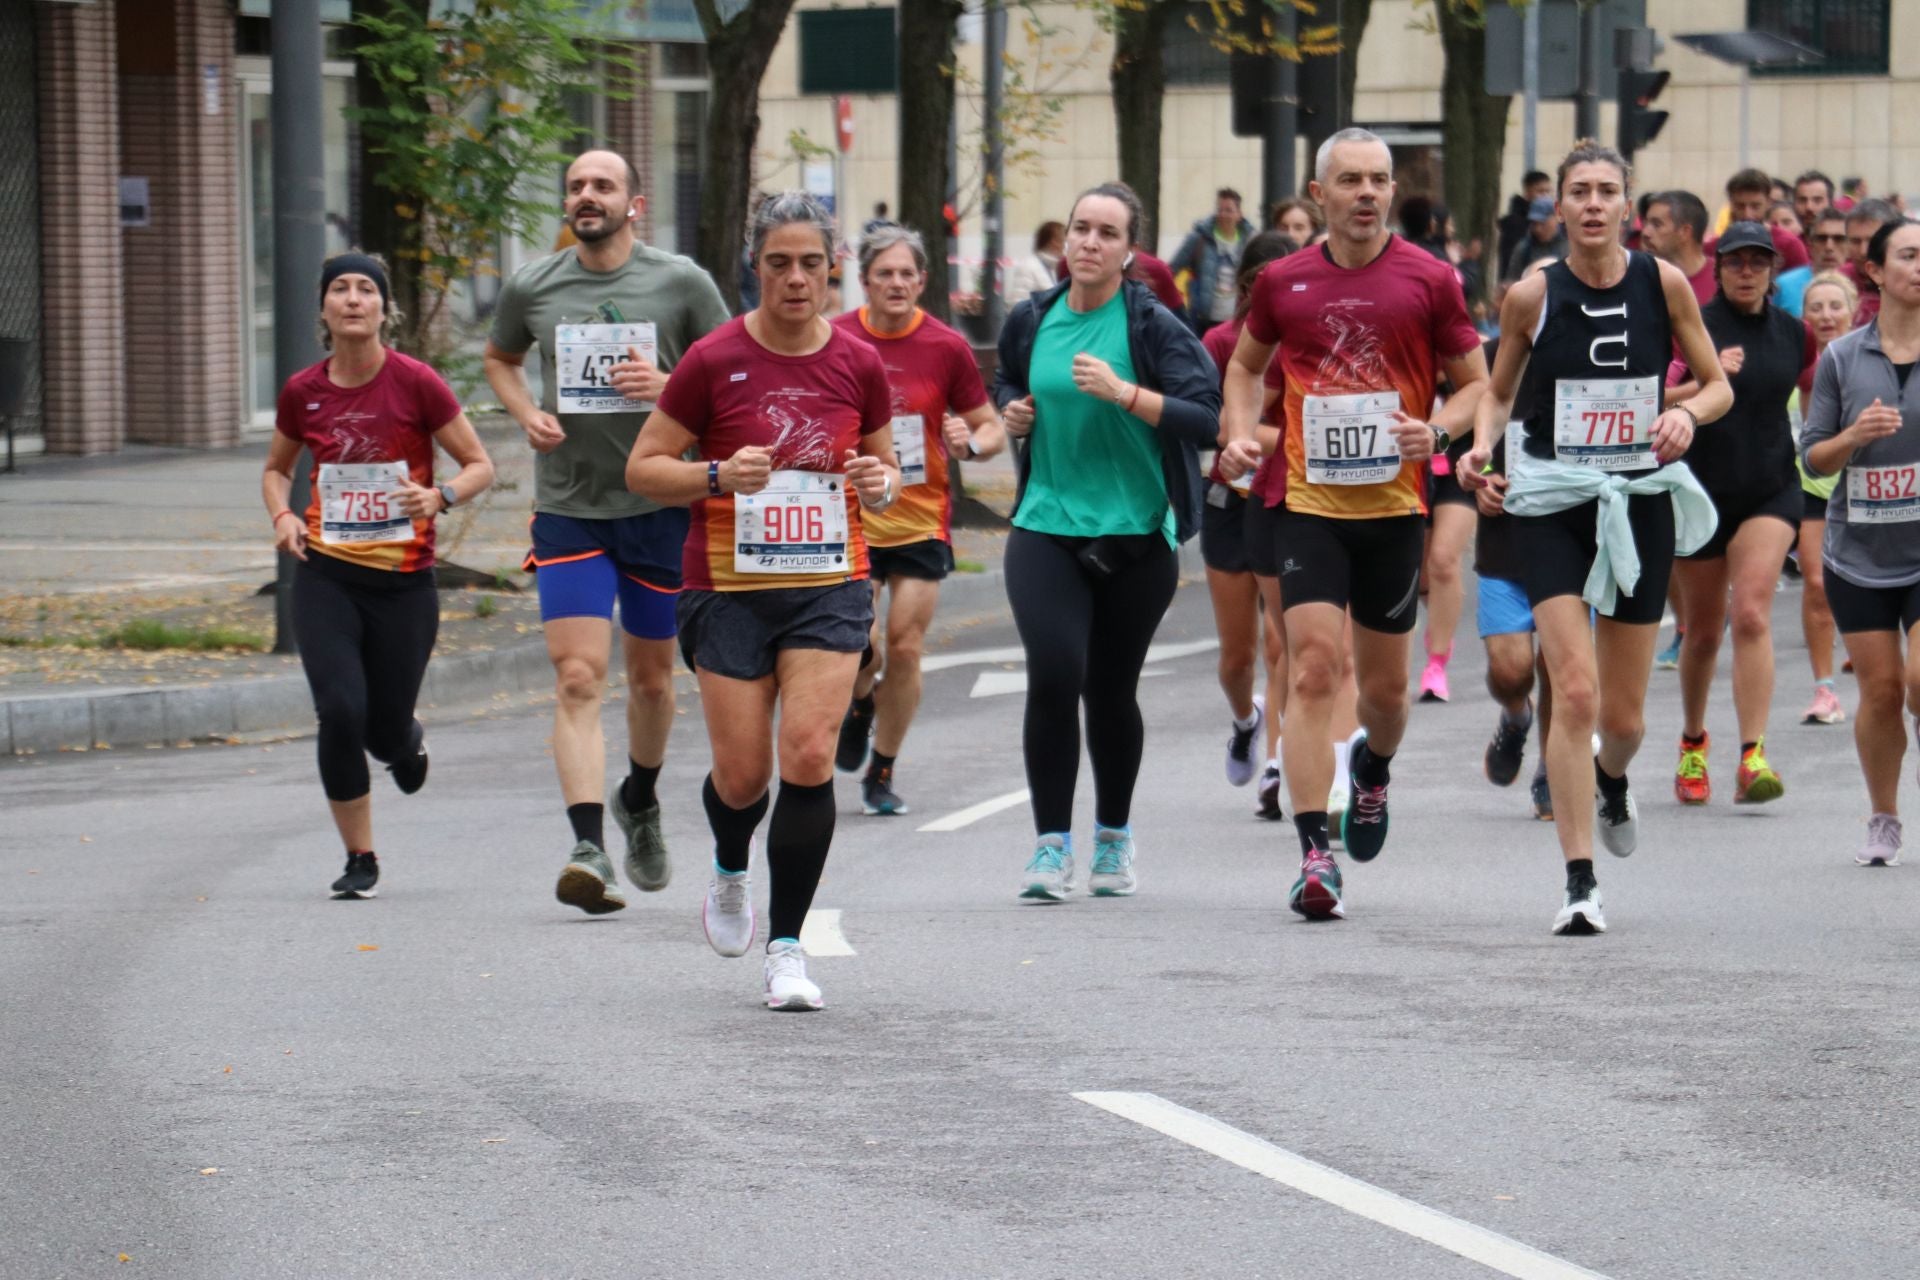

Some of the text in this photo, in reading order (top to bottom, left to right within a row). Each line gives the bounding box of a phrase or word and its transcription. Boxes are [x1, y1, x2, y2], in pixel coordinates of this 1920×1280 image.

[1581, 302, 1628, 370] JU
[1591, 402, 1628, 410] CRISTINA
[1325, 425, 1377, 458] 607
[1582, 411, 1634, 444] 776
[1341, 468, 1386, 478] HYUNDAI
[1595, 455, 1640, 464] HYUNDAI
[1866, 468, 1917, 499] 832
[341, 492, 388, 521] 735
[764, 506, 823, 542] 906
[780, 556, 829, 565] HYUNDAI
